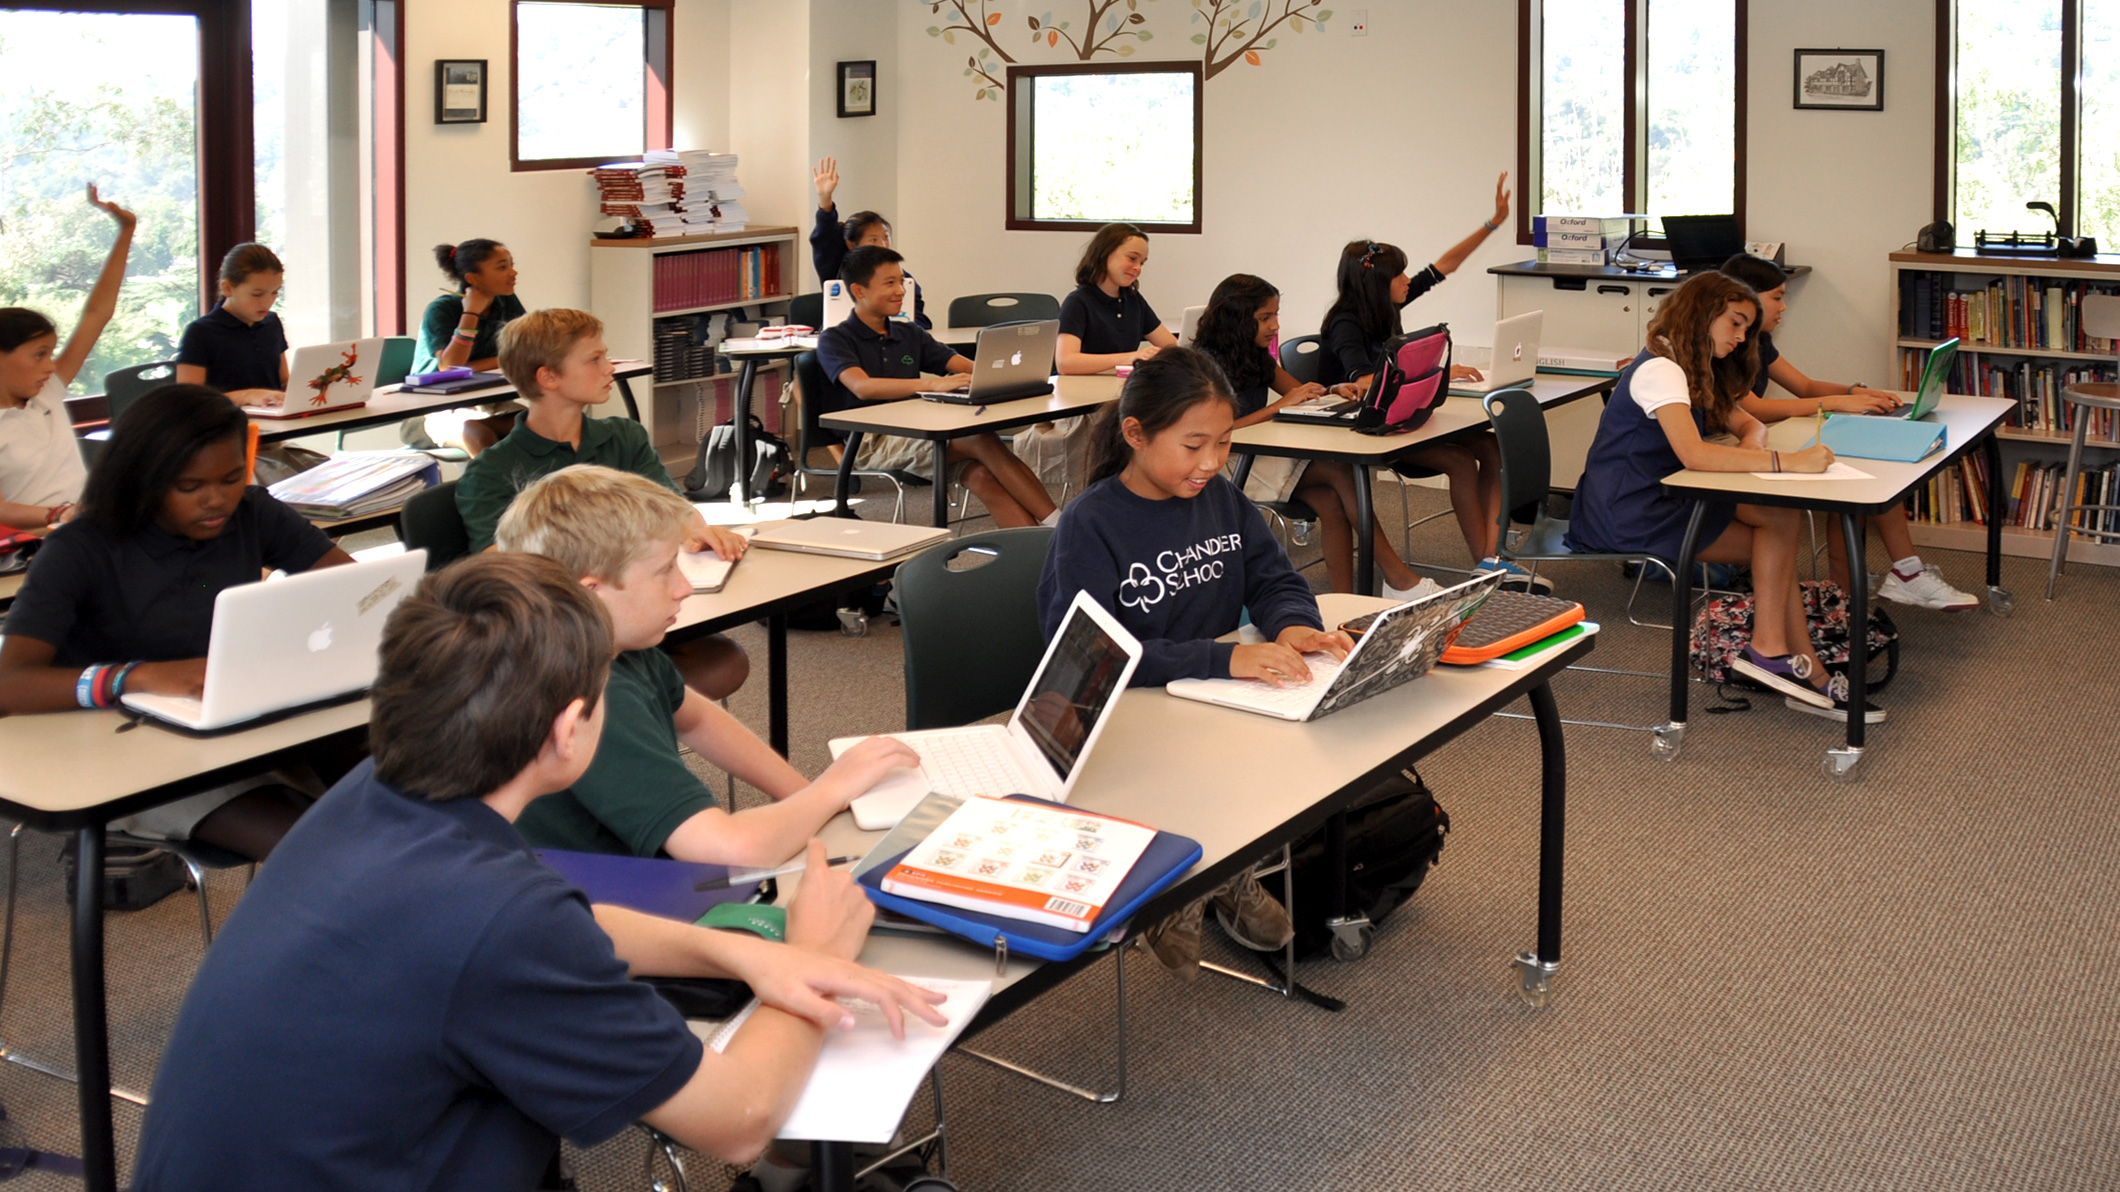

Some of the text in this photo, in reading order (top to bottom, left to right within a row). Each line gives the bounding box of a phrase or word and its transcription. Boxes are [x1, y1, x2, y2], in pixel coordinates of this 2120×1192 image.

[1536, 357, 1565, 366] GLISH
[1156, 533, 1242, 574] CHANDER
[1166, 560, 1224, 597] SCHOO
